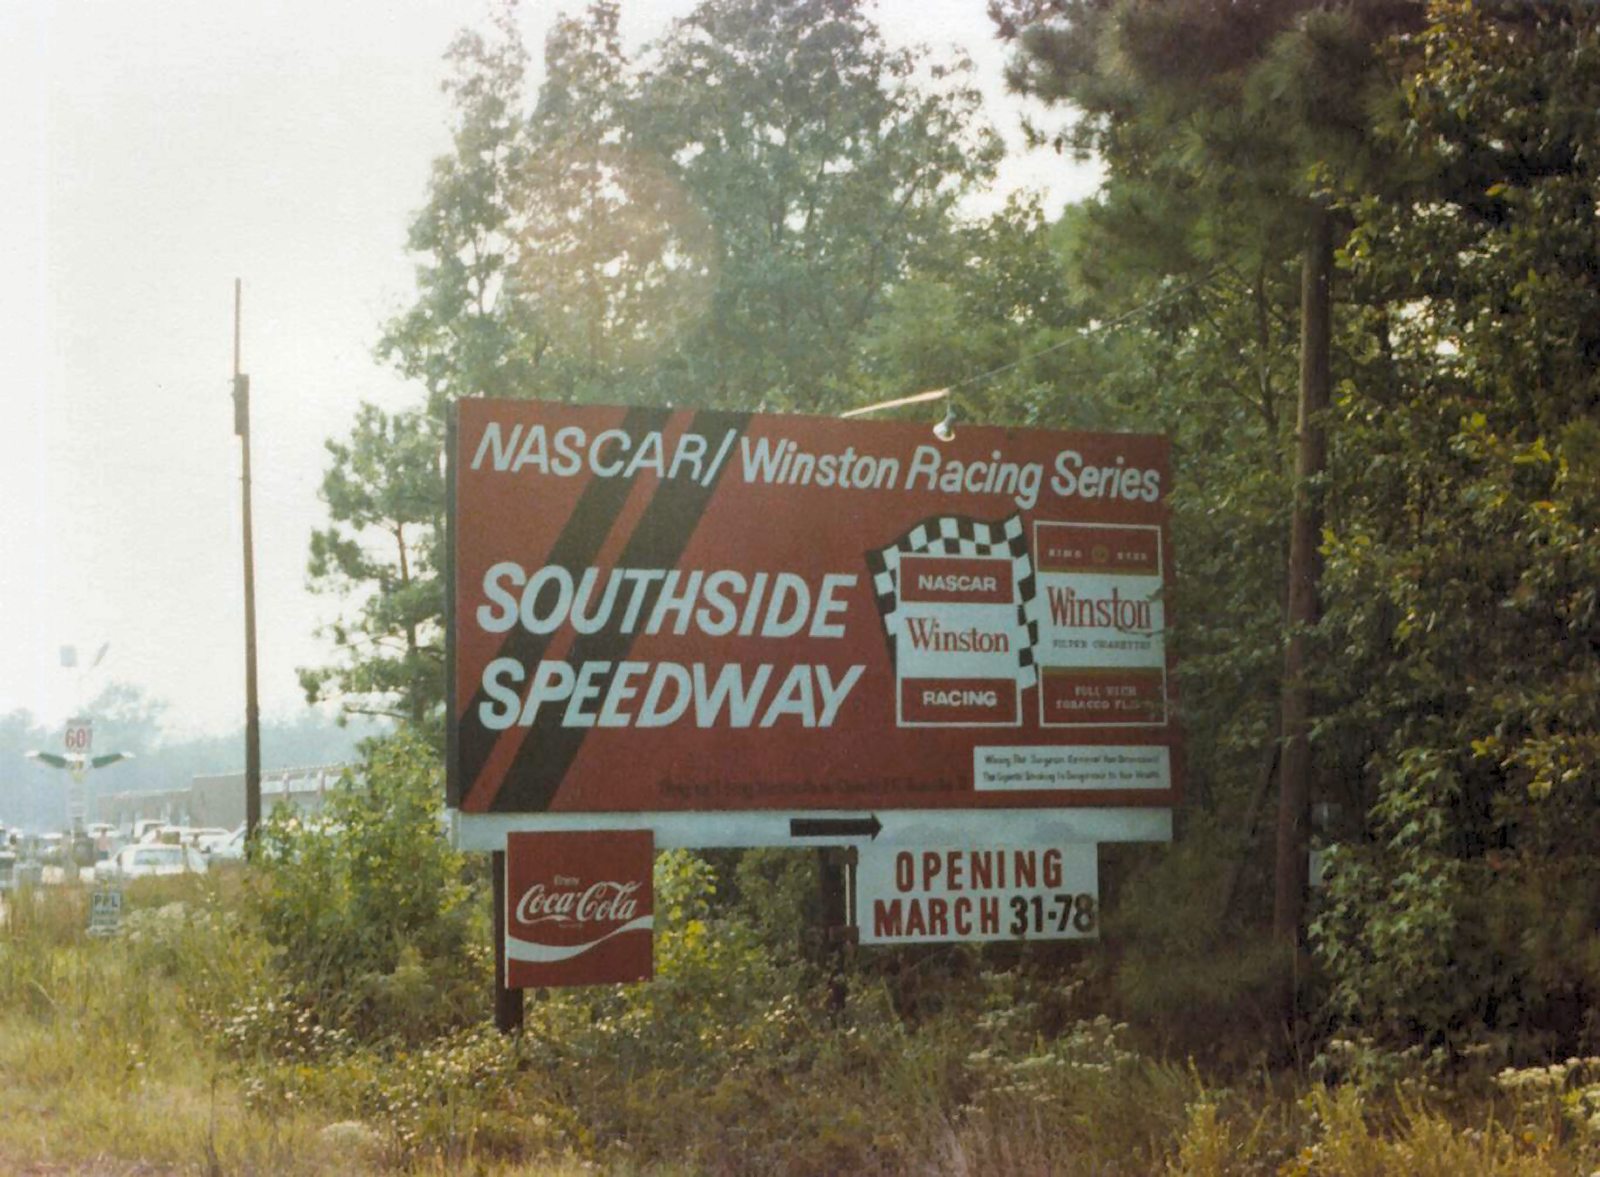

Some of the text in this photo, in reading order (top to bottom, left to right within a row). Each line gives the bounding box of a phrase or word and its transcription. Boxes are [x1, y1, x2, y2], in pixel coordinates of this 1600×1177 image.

[905, 445, 1043, 509] Racing
[1051, 450, 1160, 502] Series
[476, 561, 858, 638] SOUTHSIDE
[918, 574, 997, 592] NASCAR
[1047, 586, 1153, 630] Winston
[904, 616, 1010, 653] Winston
[478, 657, 867, 730] SPEEDWAY
[923, 690, 998, 707] RACING
[896, 848, 1062, 892] OPENING
[874, 893, 1097, 938] MARCH 31-78
